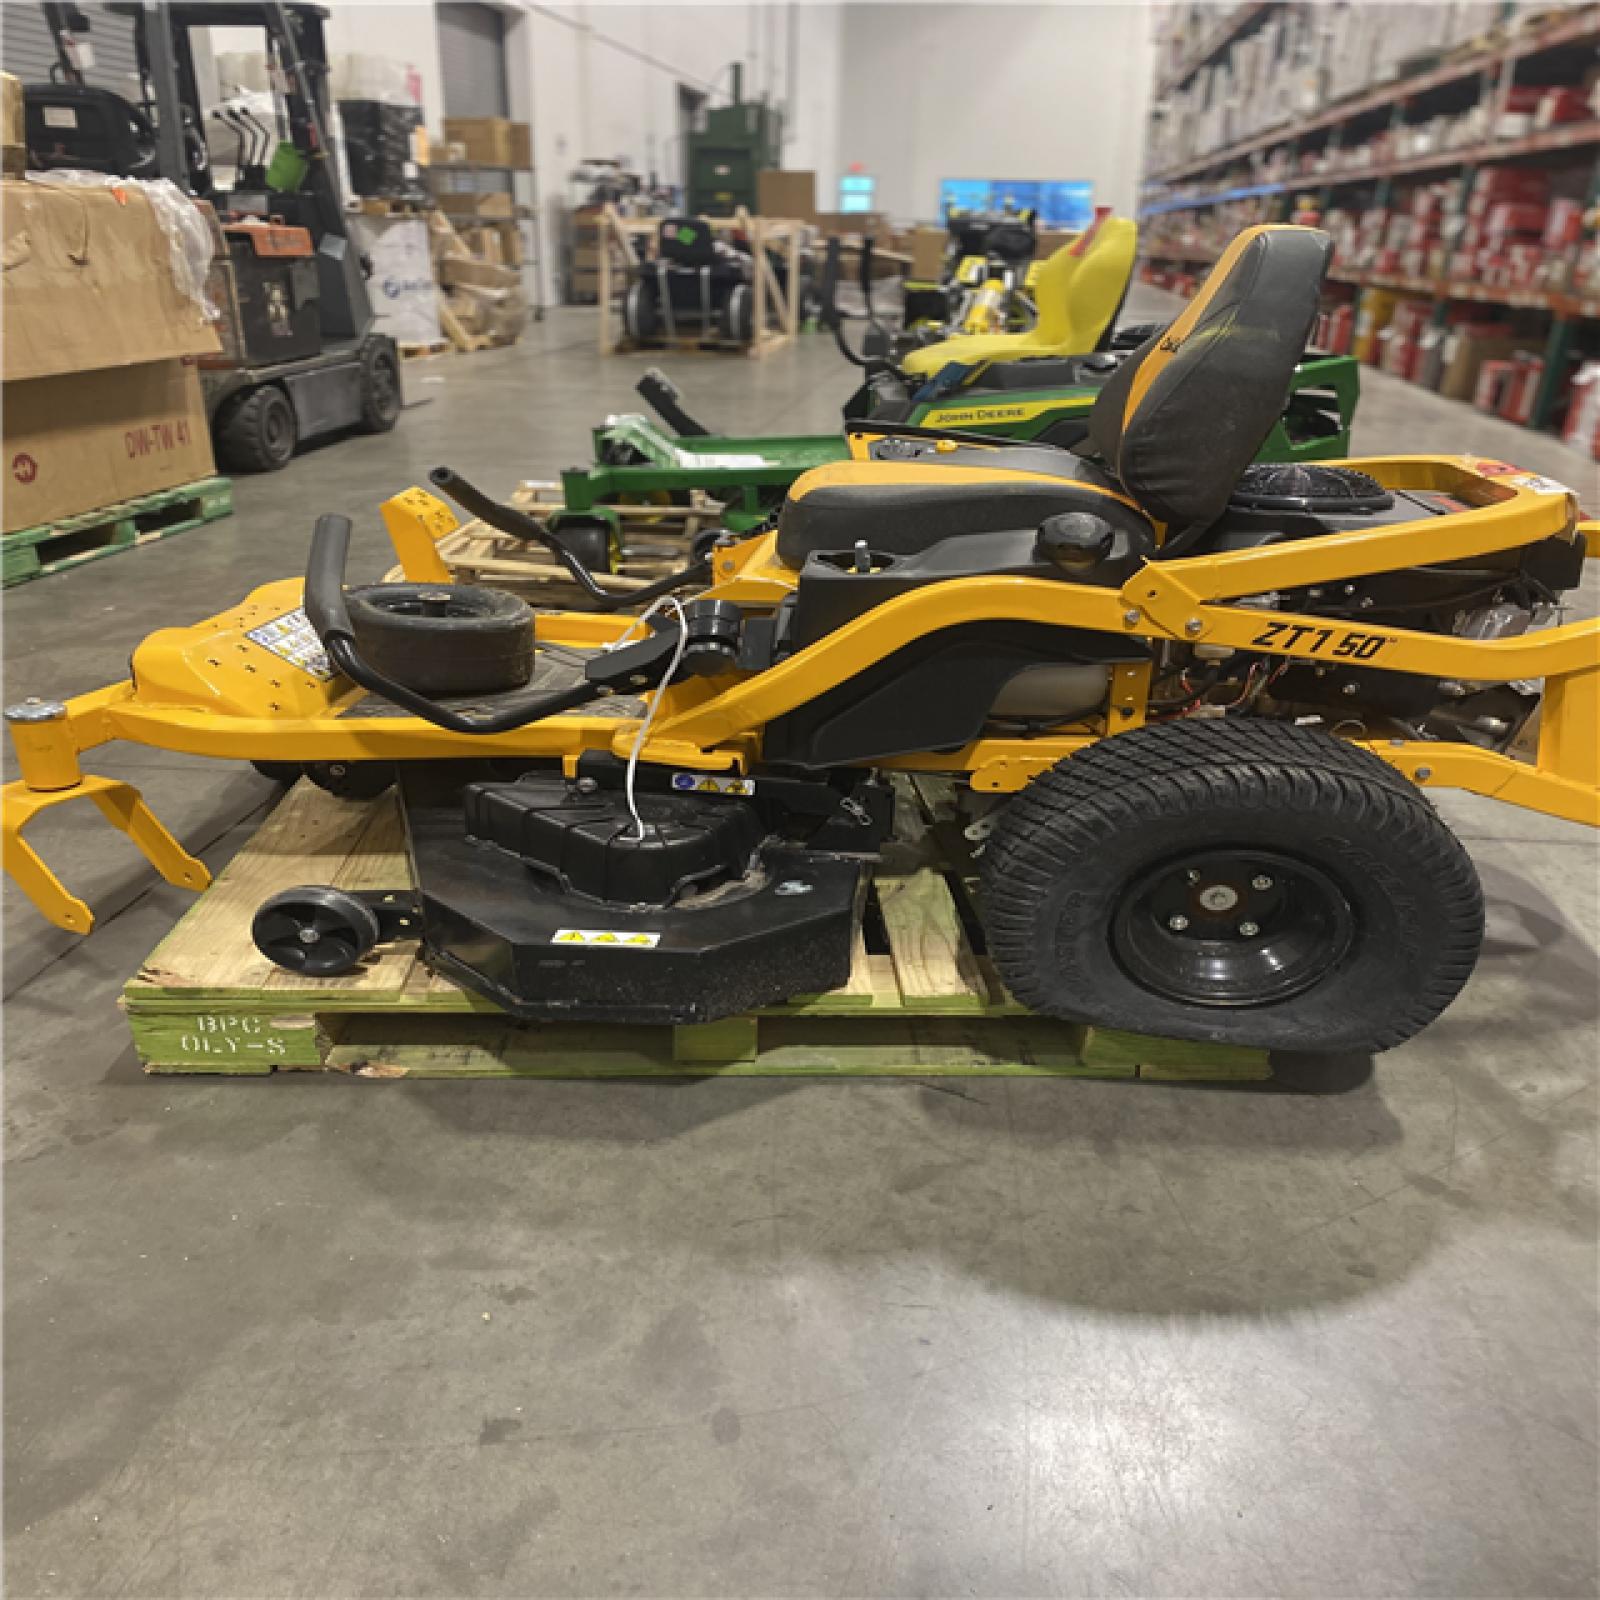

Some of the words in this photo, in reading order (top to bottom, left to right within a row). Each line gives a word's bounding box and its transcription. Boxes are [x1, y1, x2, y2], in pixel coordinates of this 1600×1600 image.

[934, 412, 973, 424] JOHN
[976, 407, 1026, 421] DEERE
[1252, 622, 1335, 653] ZT1
